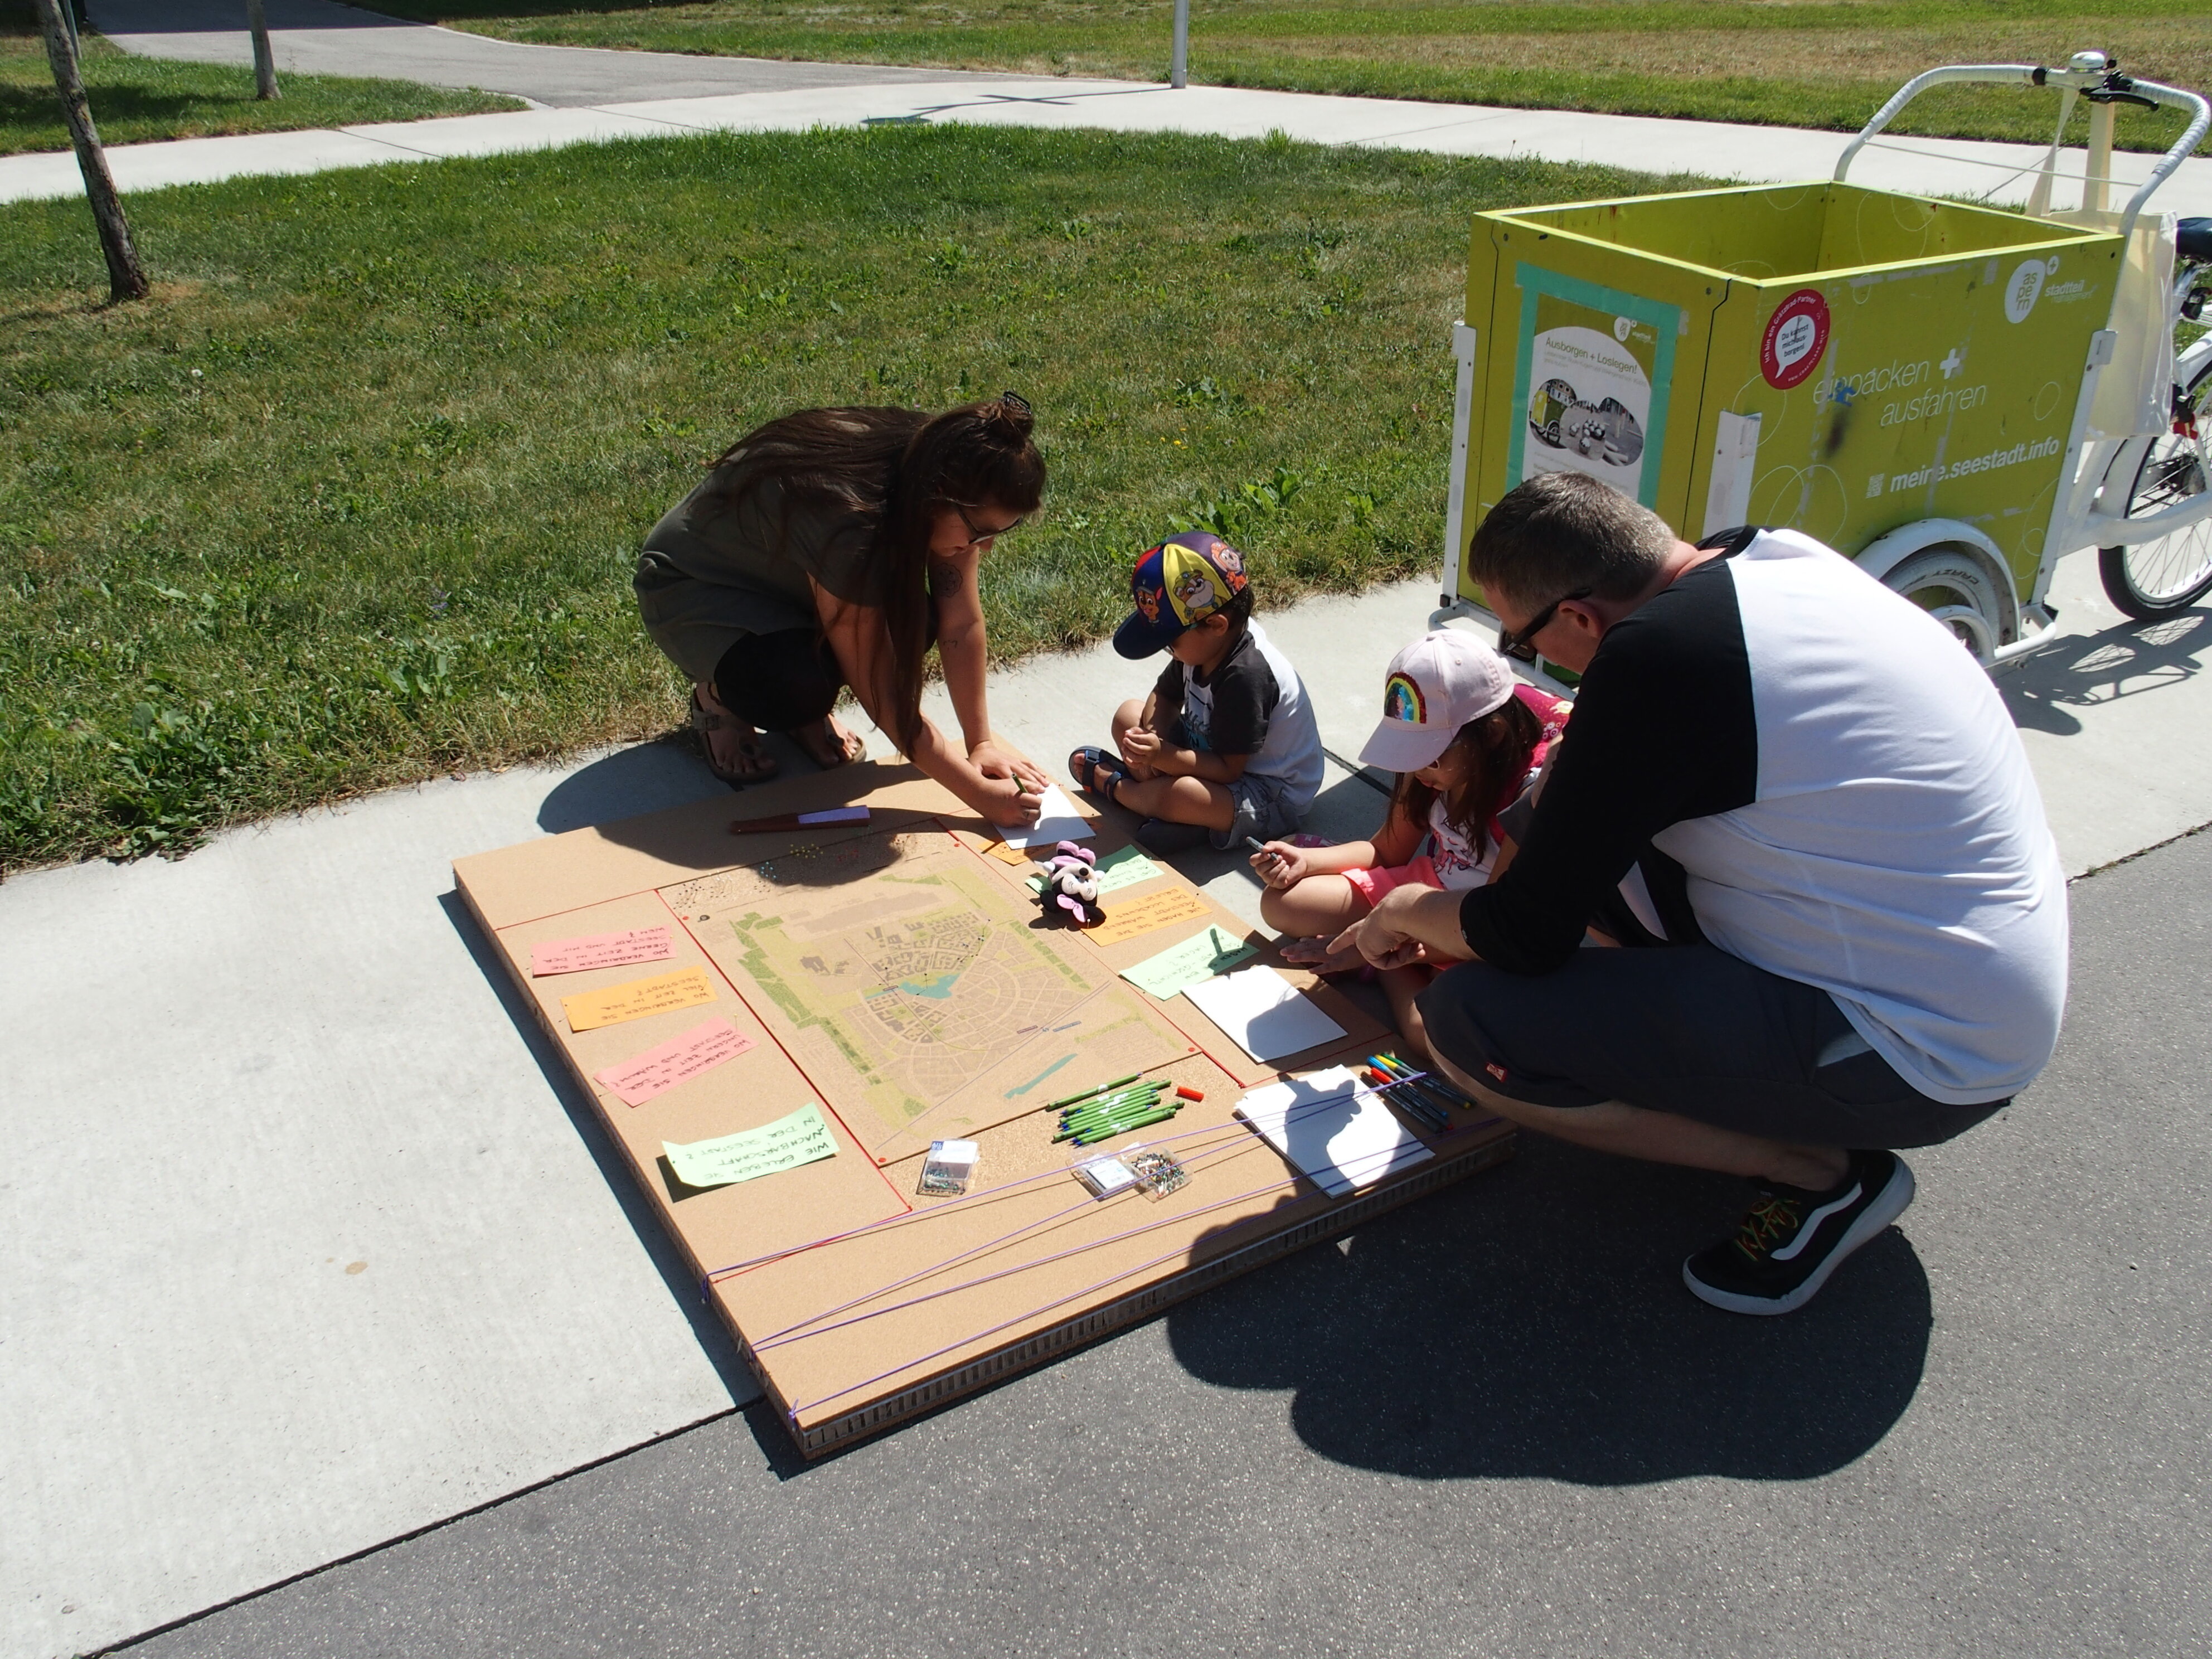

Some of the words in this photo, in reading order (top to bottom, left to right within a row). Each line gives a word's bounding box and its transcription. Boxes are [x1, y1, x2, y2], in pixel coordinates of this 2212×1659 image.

[2044, 279, 2085, 297] stadtteil
[1781, 332, 1789, 341] Du
[1545, 336, 1589, 360] Ausborgen
[1597, 352, 1638, 375] Loslegen!
[1783, 343, 1805, 357] borgen!
[1813, 360, 1929, 405] einpacken
[1880, 385, 1987, 427] ausfahren
[1890, 435, 2060, 493] meine.seestadt.info
[1931, 569, 1980, 585] CRAZY
[631, 942, 668, 951] GERNE
[652, 1078, 671, 1090] SIE
[803, 1115, 816, 1126] IN
[767, 1126, 798, 1138] DER
[806, 1142, 830, 1155] WIE
[734, 1154, 795, 1175] ERLEBEN
